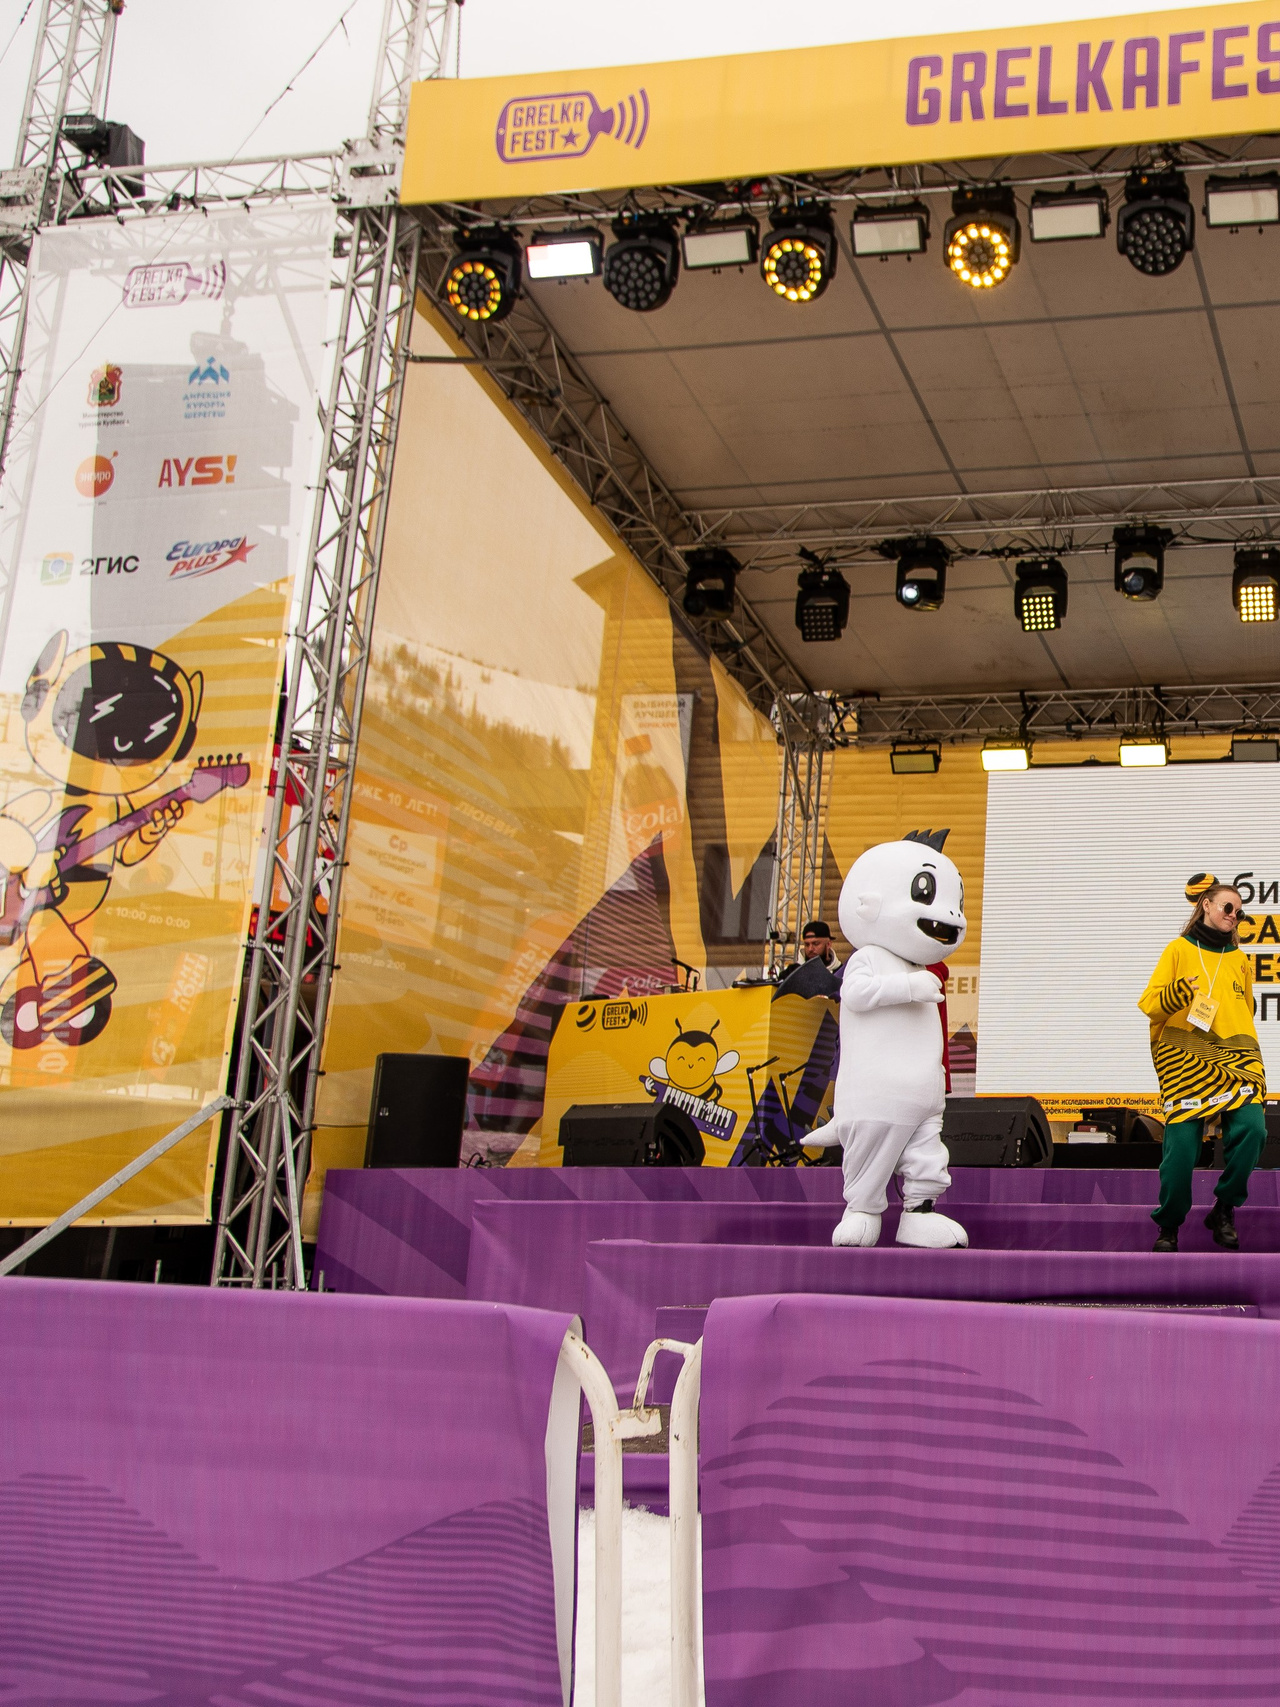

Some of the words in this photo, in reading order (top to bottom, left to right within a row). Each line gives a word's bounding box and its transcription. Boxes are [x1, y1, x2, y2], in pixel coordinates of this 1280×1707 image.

[511, 101, 586, 129] GRELKA
[510, 128, 558, 154] FEST
[135, 268, 184, 285] GRELKA
[131, 286, 165, 302] FEST
[158, 455, 238, 489] AYS!
[80, 554, 140, 577] 2ГИС
[116, 906, 147, 921] 10:00
[165, 915, 191, 929] 0:00
[606, 1005, 629, 1016] GRELKA
[605, 1016, 621, 1026] FEST
[1105, 1097, 1121, 1105] ООО
